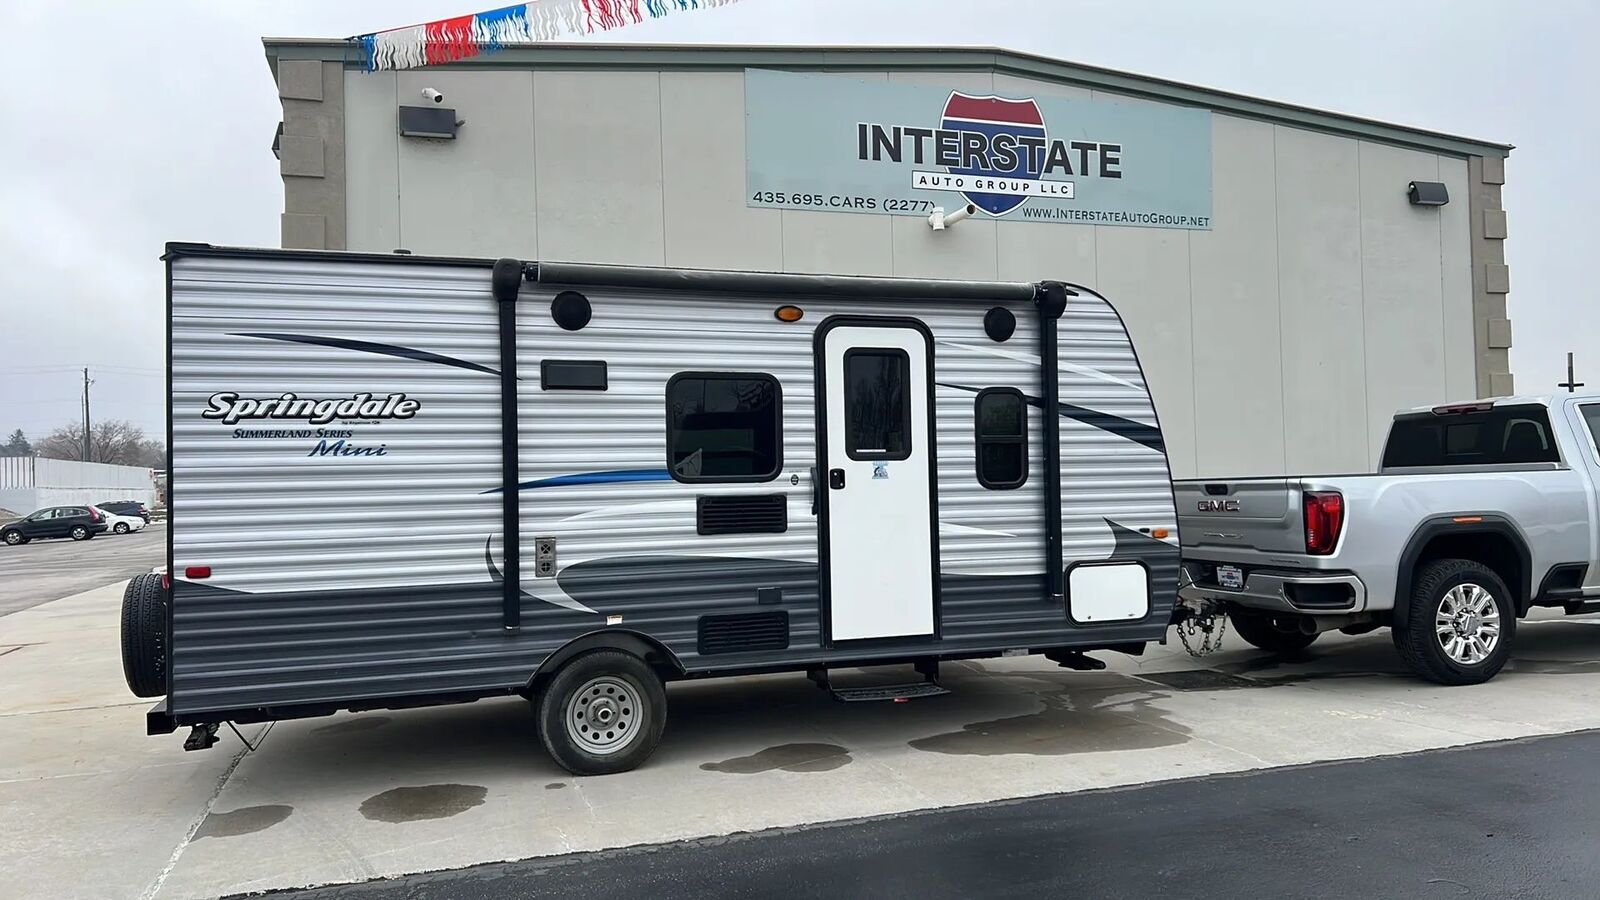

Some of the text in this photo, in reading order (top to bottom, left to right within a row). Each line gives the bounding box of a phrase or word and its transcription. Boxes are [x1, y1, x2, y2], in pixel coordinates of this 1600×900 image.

[857, 122, 1122, 179] INTERSTATE
[919, 175, 1069, 194] AUTO GROUP LLC
[752, 191, 877, 210] 435.695.CARS
[202, 391, 421, 425] Springdale
[307, 439, 388, 457] Mini
[1197, 499, 1241, 513] GMC
